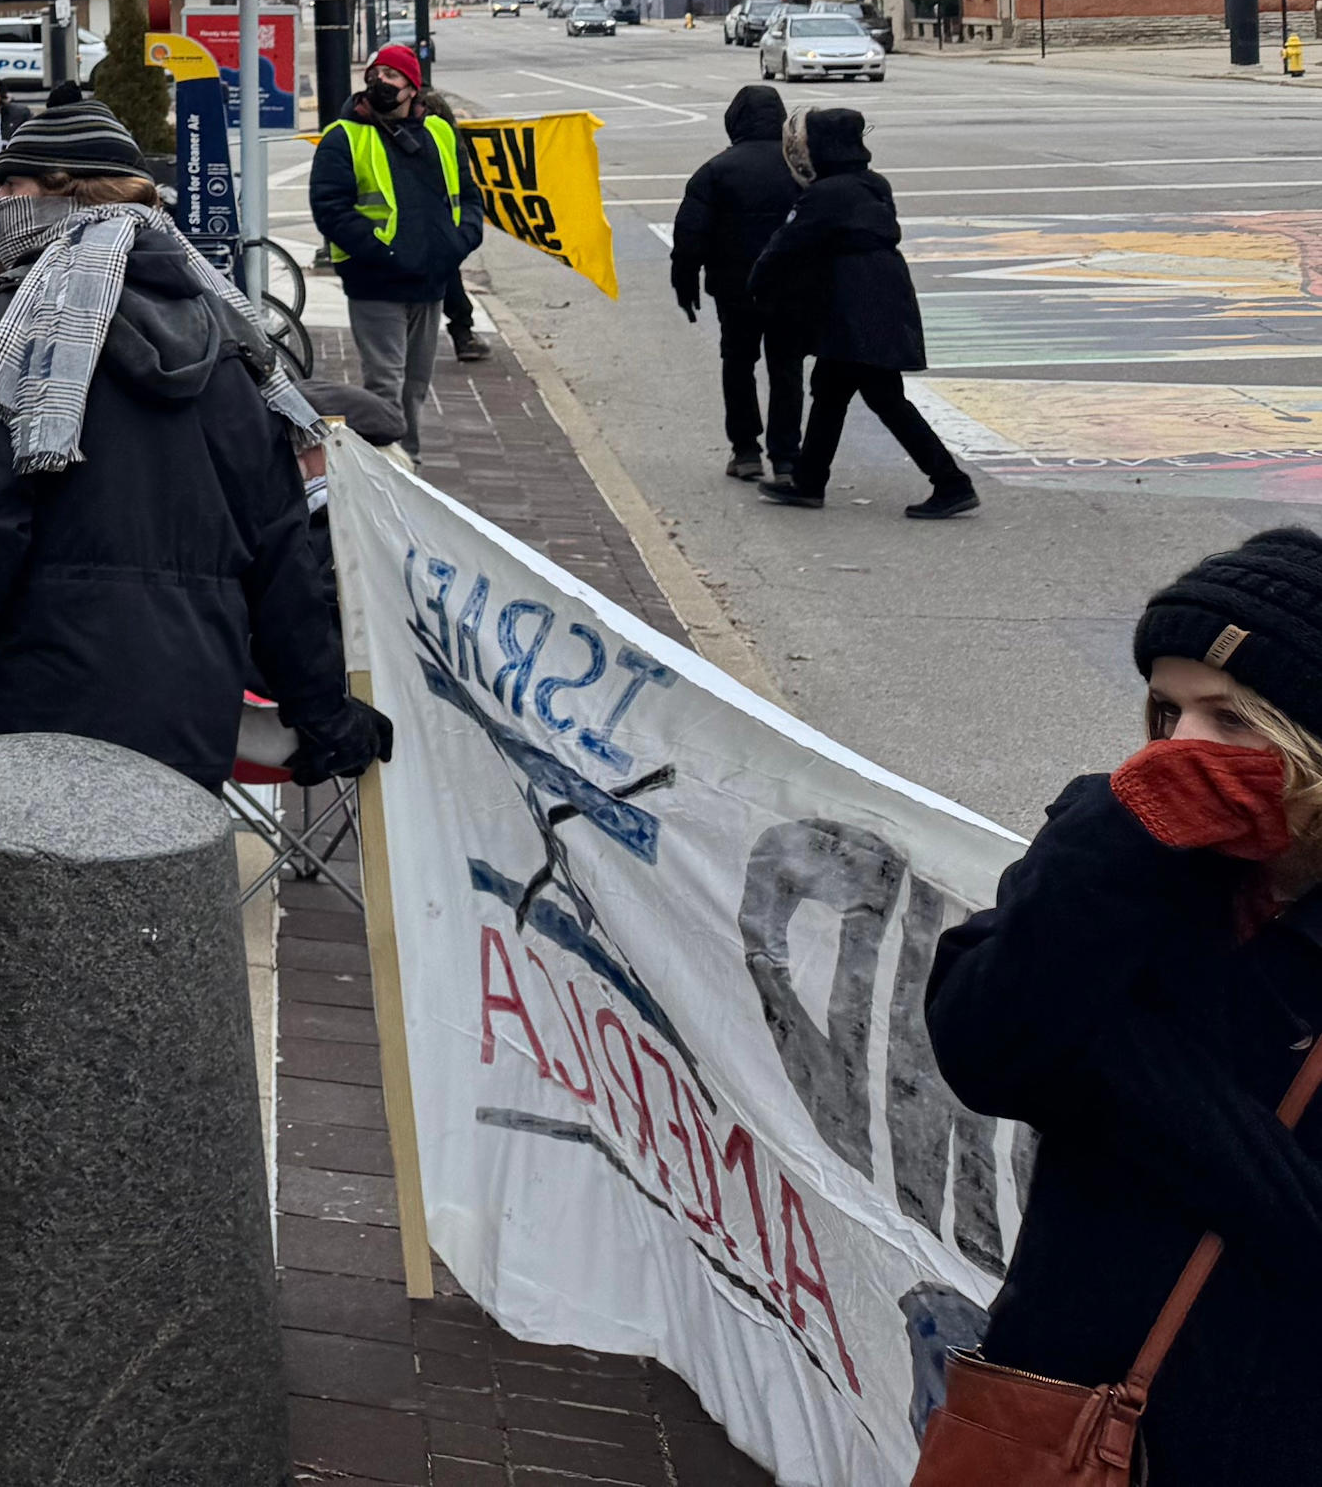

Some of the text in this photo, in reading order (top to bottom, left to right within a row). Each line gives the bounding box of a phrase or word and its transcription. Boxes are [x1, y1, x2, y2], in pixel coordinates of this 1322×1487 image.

[187, 113, 200, 131] Air
[187, 133, 201, 174] Cleaner
[187, 175, 201, 192] for
[188, 194, 201, 225] Share
[1030, 456, 1210, 467] LOVE
